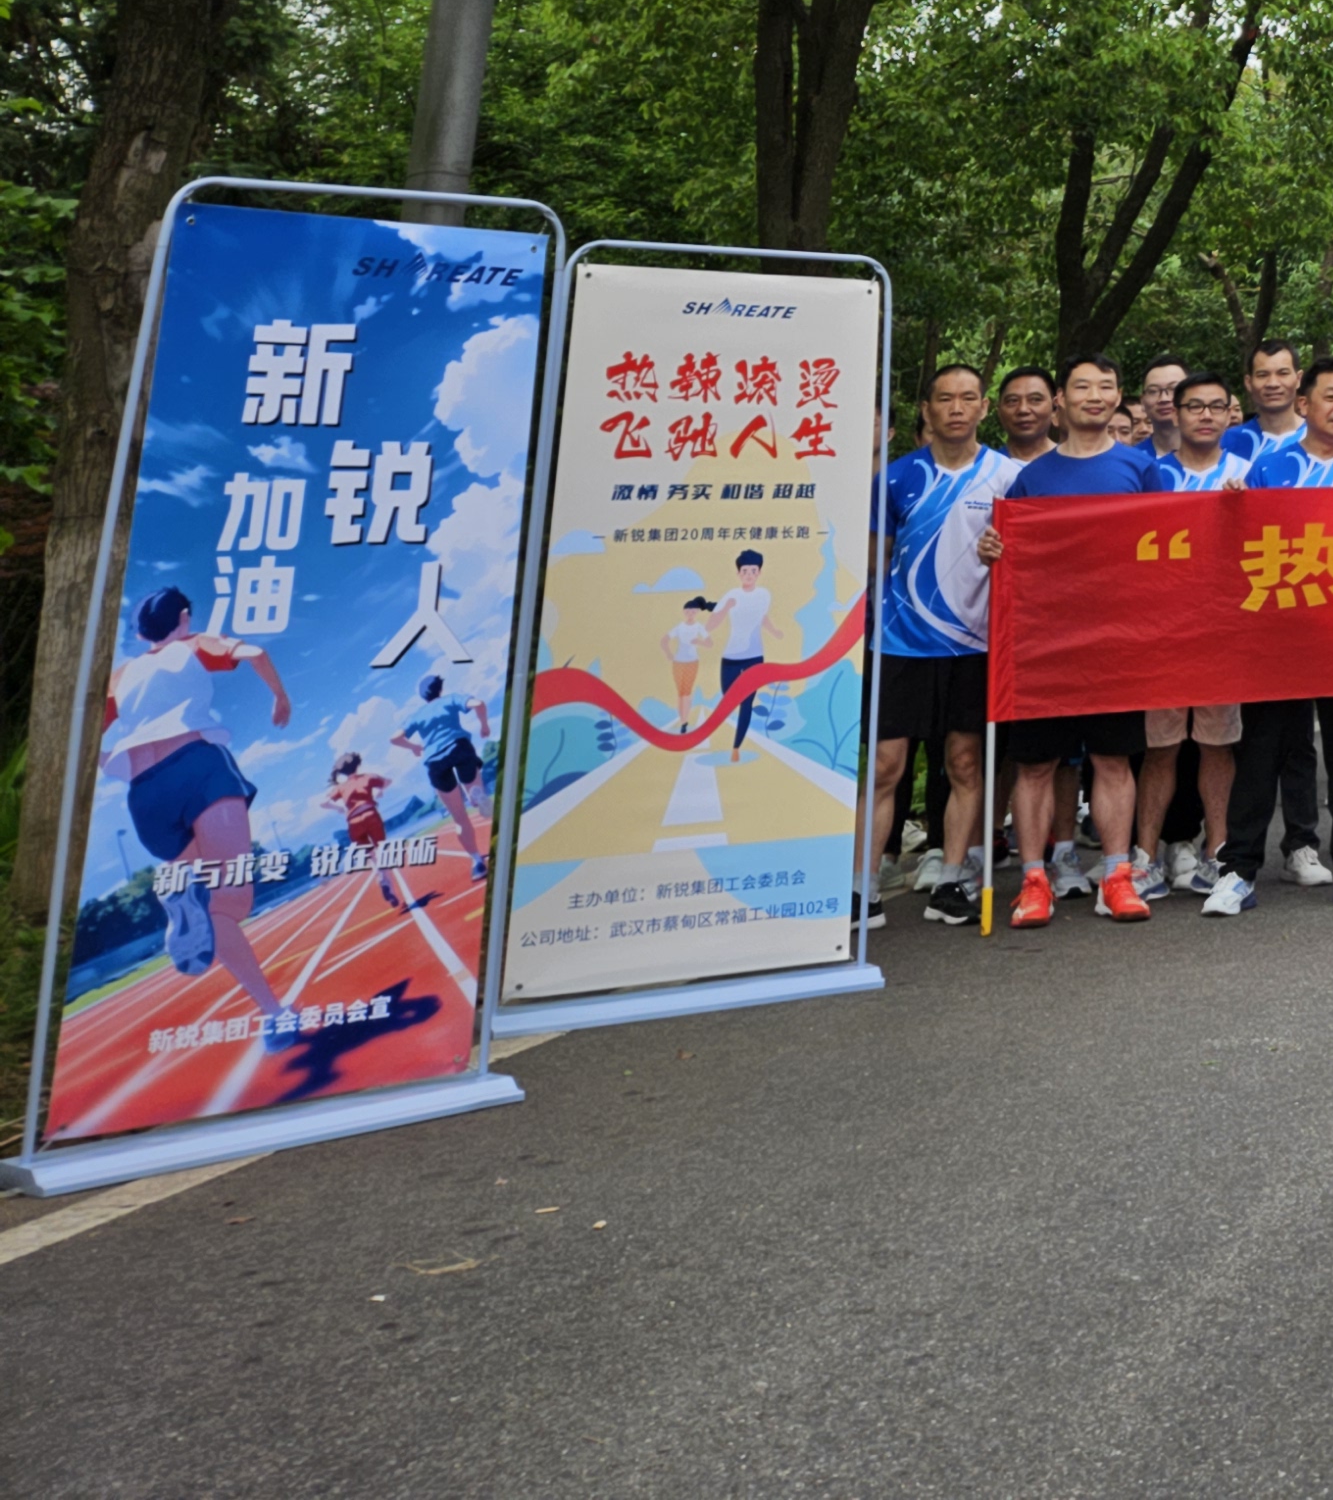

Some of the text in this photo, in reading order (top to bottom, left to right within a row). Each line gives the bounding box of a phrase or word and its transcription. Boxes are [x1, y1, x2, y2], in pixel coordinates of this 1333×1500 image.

[605, 351, 840, 409] 热辣滚烫
[599, 410, 837, 460] 飞驰人生
[667, 484, 713, 500] 务实
[720, 483, 765, 500] 和谐
[772, 483, 816, 499] 超越
[207, 472, 303, 636] 加油
[152, 836, 438, 896] 新与求变 锐在砥砺
[148, 995, 391, 1053] 新锐集团工会委员会宣
